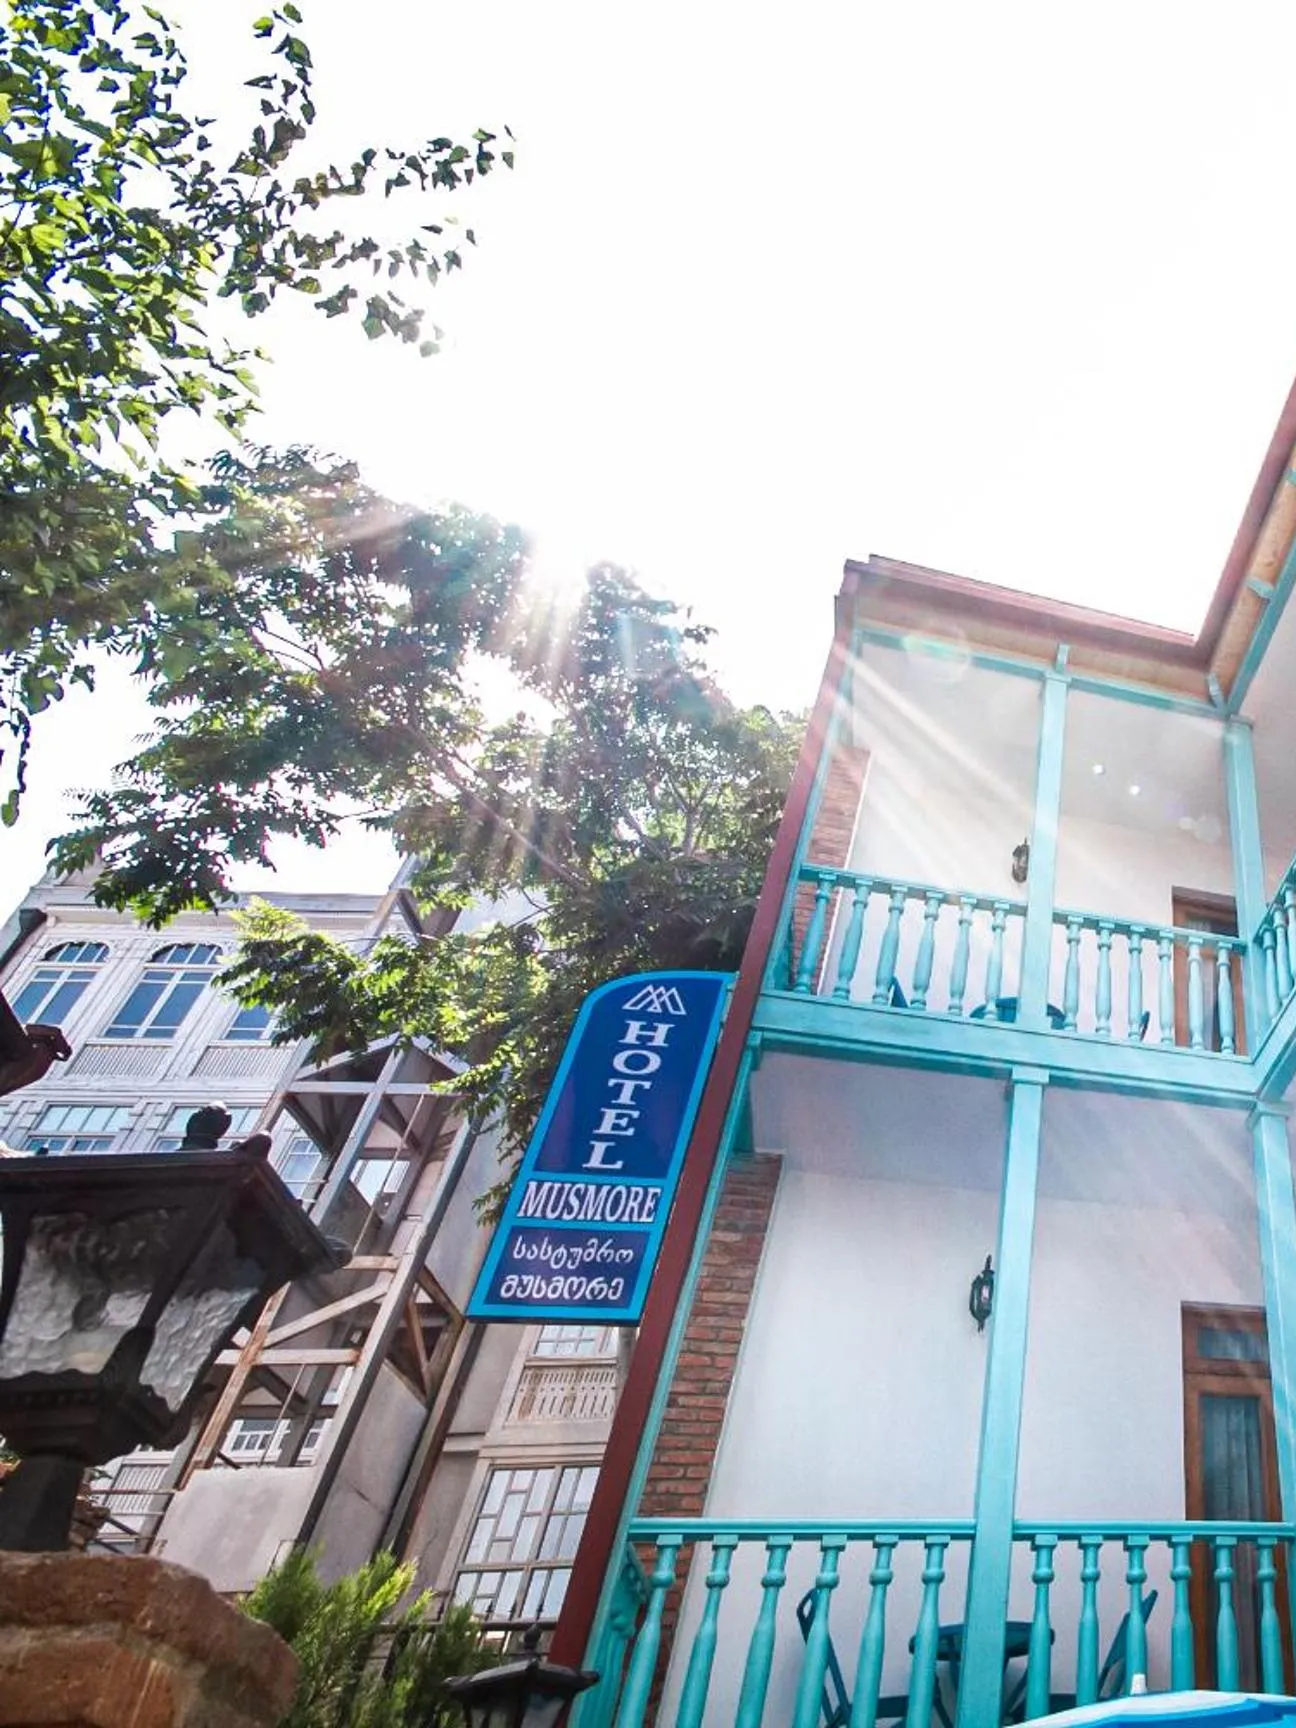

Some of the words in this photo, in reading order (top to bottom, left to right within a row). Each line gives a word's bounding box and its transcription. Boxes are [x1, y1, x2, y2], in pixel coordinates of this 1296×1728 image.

[582, 1020, 675, 1170] HOTEL
[516, 1180, 662, 1223] MUSMORE
[512, 1235, 634, 1270] სასტუმრო
